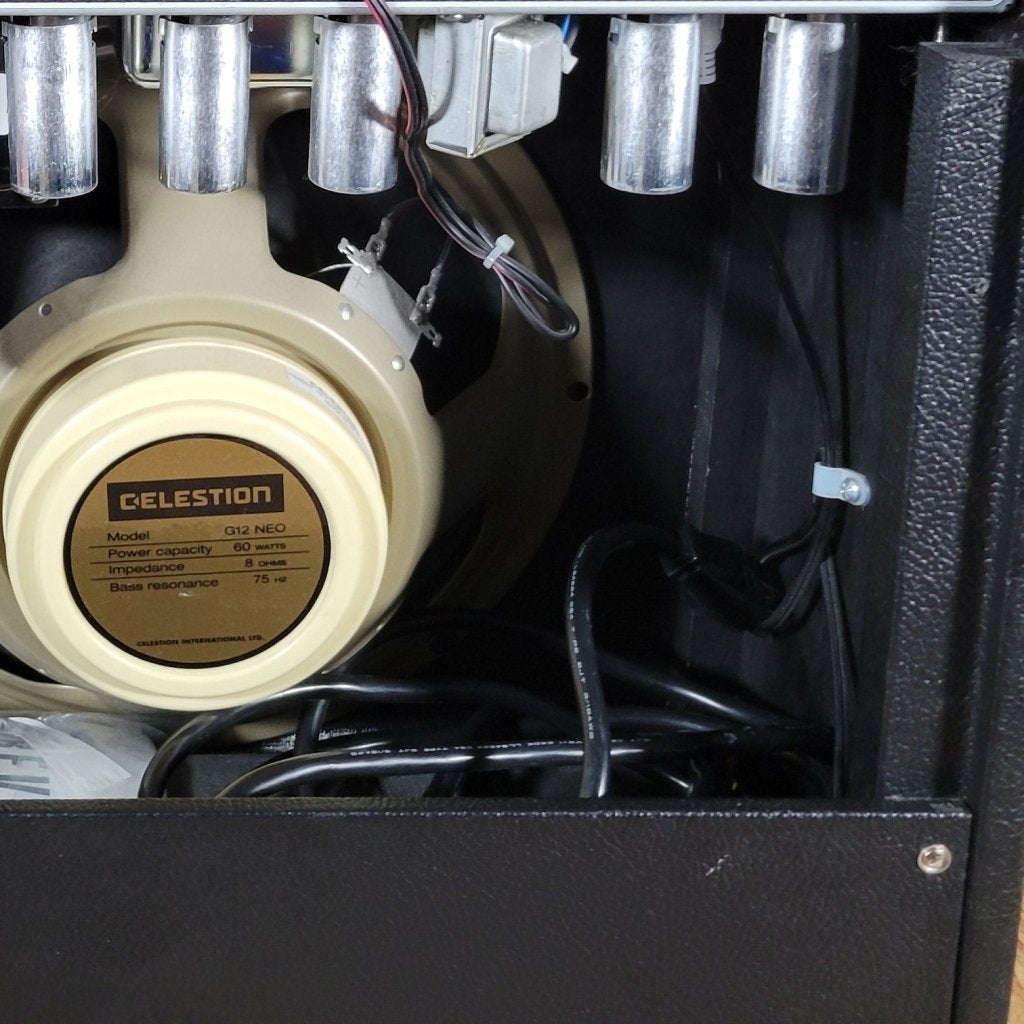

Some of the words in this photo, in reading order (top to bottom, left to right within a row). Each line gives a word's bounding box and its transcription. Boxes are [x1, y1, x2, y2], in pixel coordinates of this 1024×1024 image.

[120, 486, 271, 511] CELESTION
[107, 531, 150, 542] Model
[224, 525, 250, 536] G12
[254, 523, 286, 534] NEO
[108, 547, 151, 558] Power
[156, 544, 212, 558] capacity
[233, 542, 251, 552] 60
[255, 543, 287, 551] WATTS
[109, 562, 185, 575] Impedance
[244, 559, 254, 568] 8
[110, 582, 144, 592] Bass
[147, 578, 219, 590] resonance
[253, 574, 270, 584] 75
[137, 639, 178, 647] CELESTION
[181, 637, 246, 645] INTERNATIONAL
